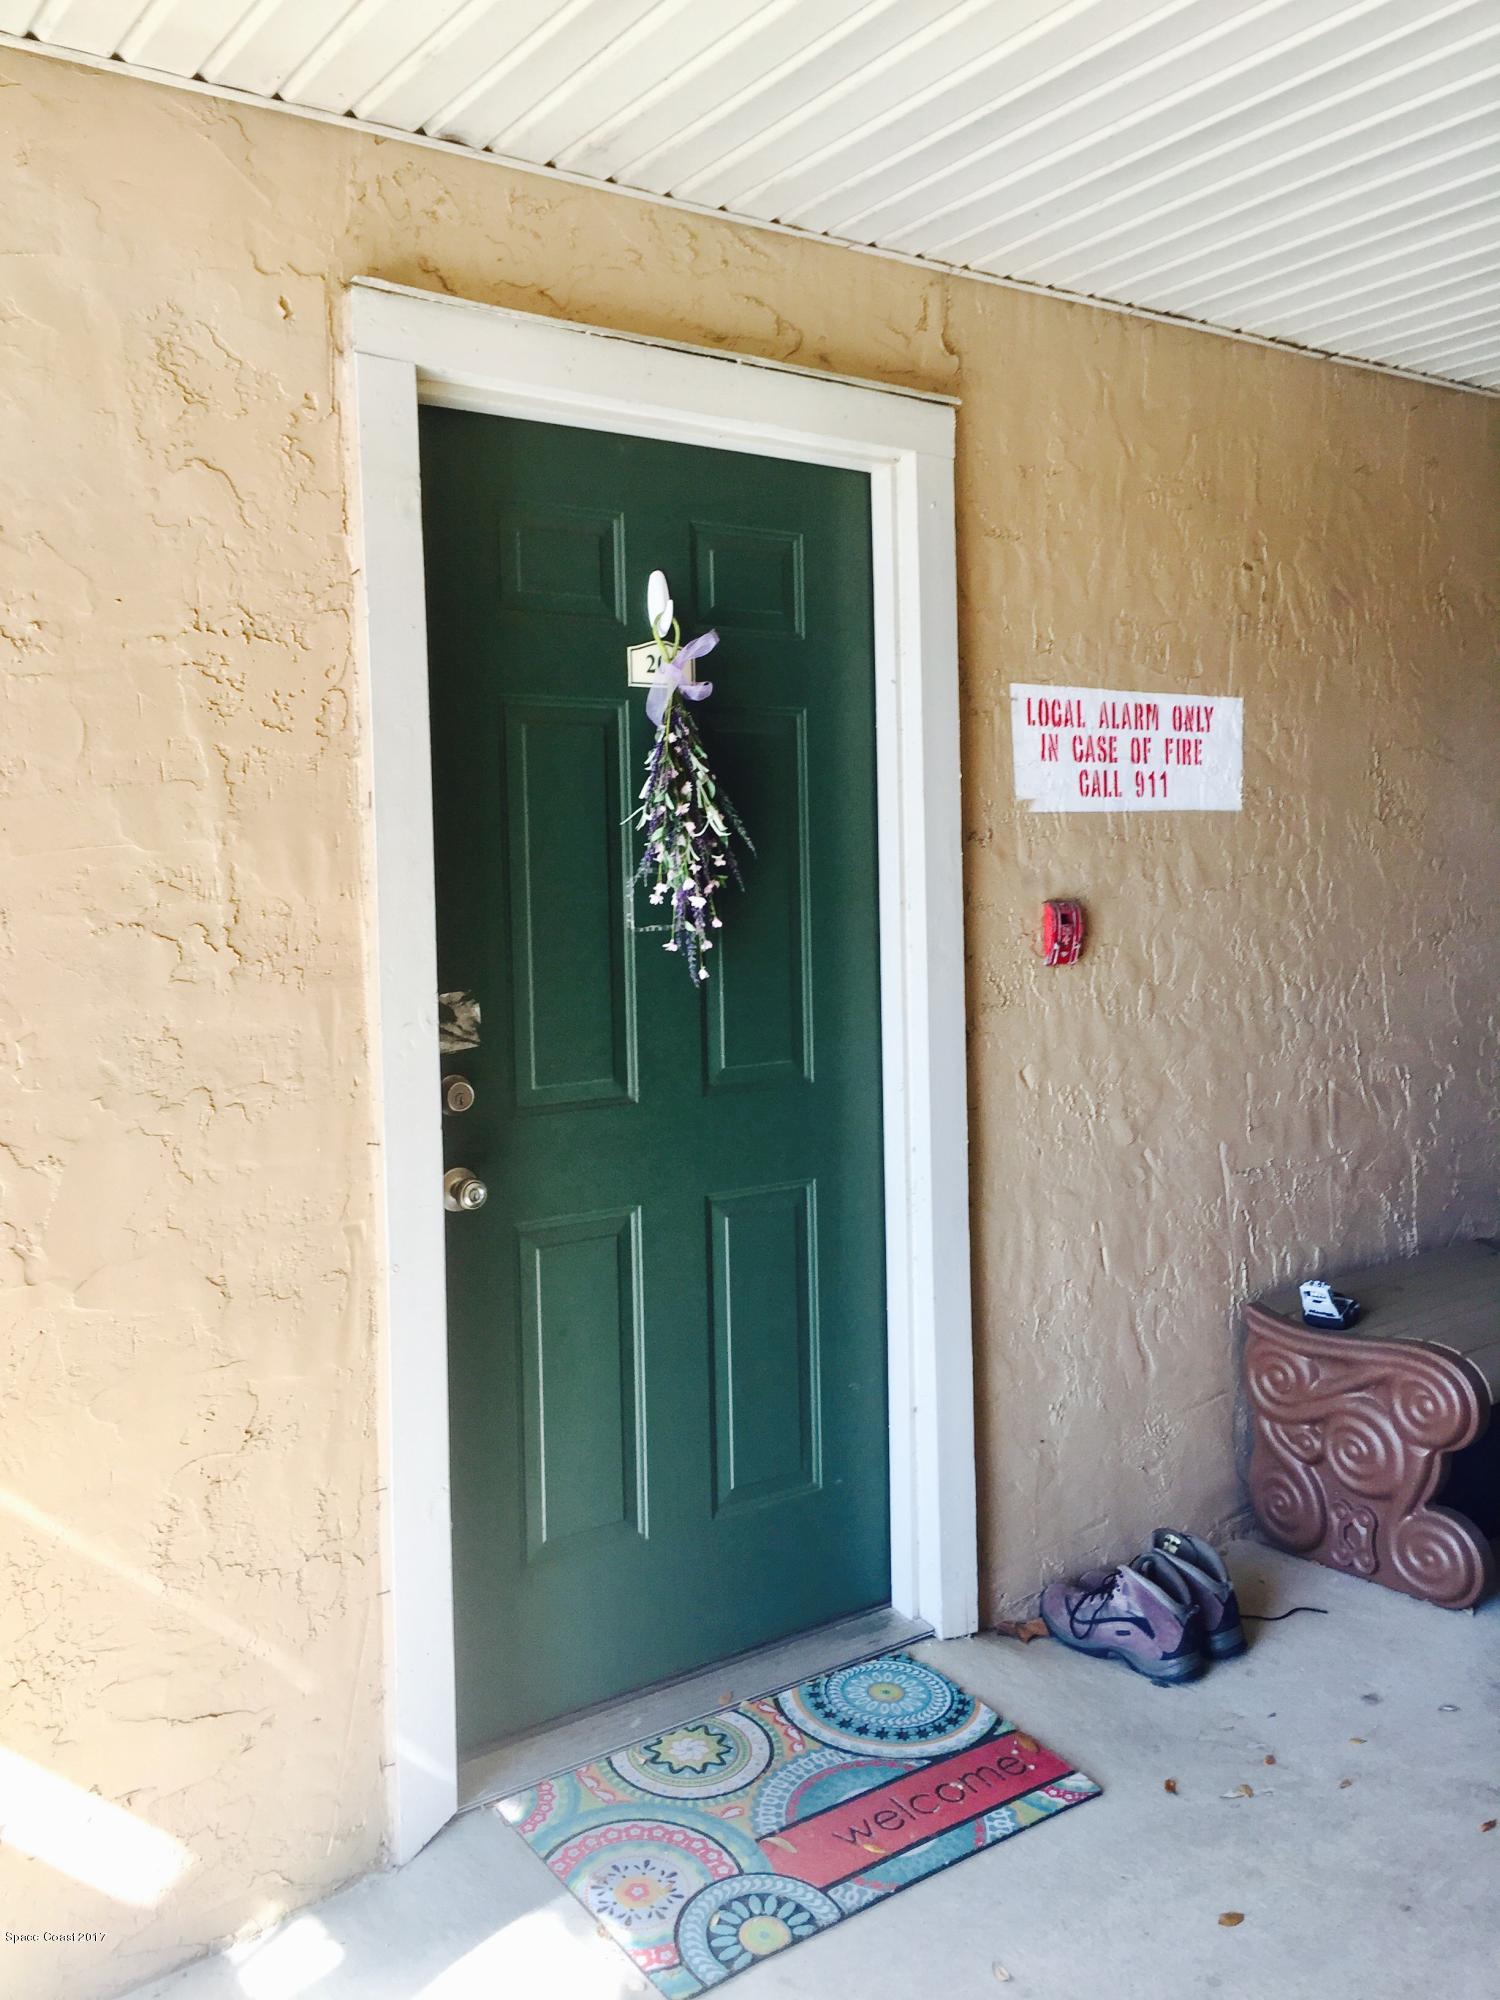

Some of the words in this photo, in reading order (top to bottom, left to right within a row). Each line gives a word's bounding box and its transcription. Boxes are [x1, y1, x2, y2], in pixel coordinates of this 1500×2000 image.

[1026, 697, 1086, 728] LOCAL
[1098, 701, 1160, 731] ALARM
[1172, 705, 1214, 733] ONLY
[1041, 733, 1059, 762] IN
[1072, 735, 1118, 763] CASE
[1130, 737, 1151, 765] OF
[1165, 738, 1203, 766] FIRE
[1079, 769, 1123, 798] CALL
[1135, 770, 1168, 798] 911
[831, 1755, 1028, 1845] welcome
